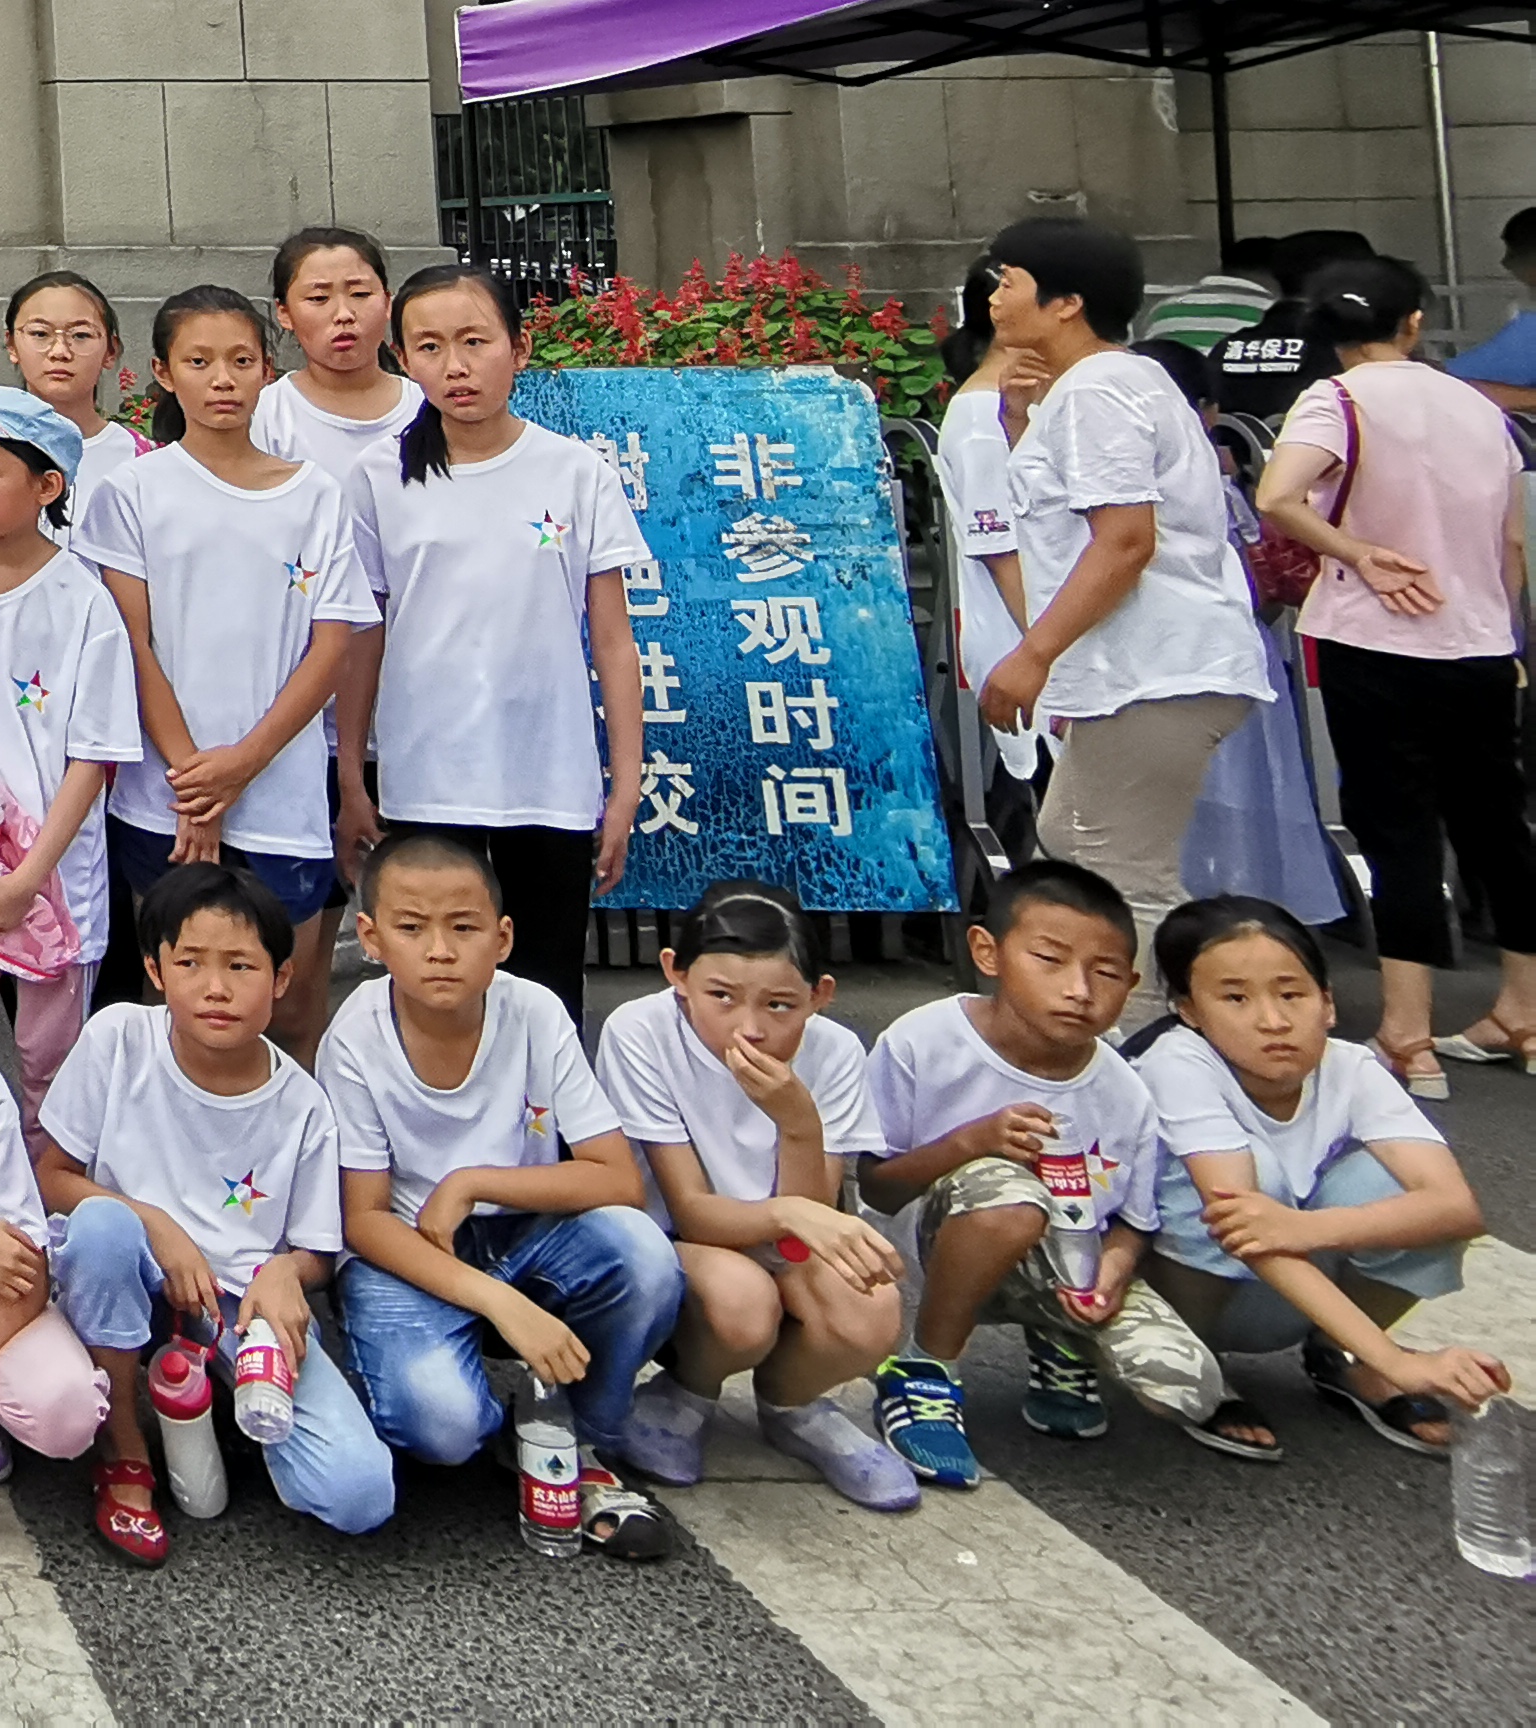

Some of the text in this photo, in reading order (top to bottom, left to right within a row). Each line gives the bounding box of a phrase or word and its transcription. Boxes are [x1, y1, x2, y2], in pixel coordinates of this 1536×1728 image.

[709, 432, 853, 837] 非参观时间
